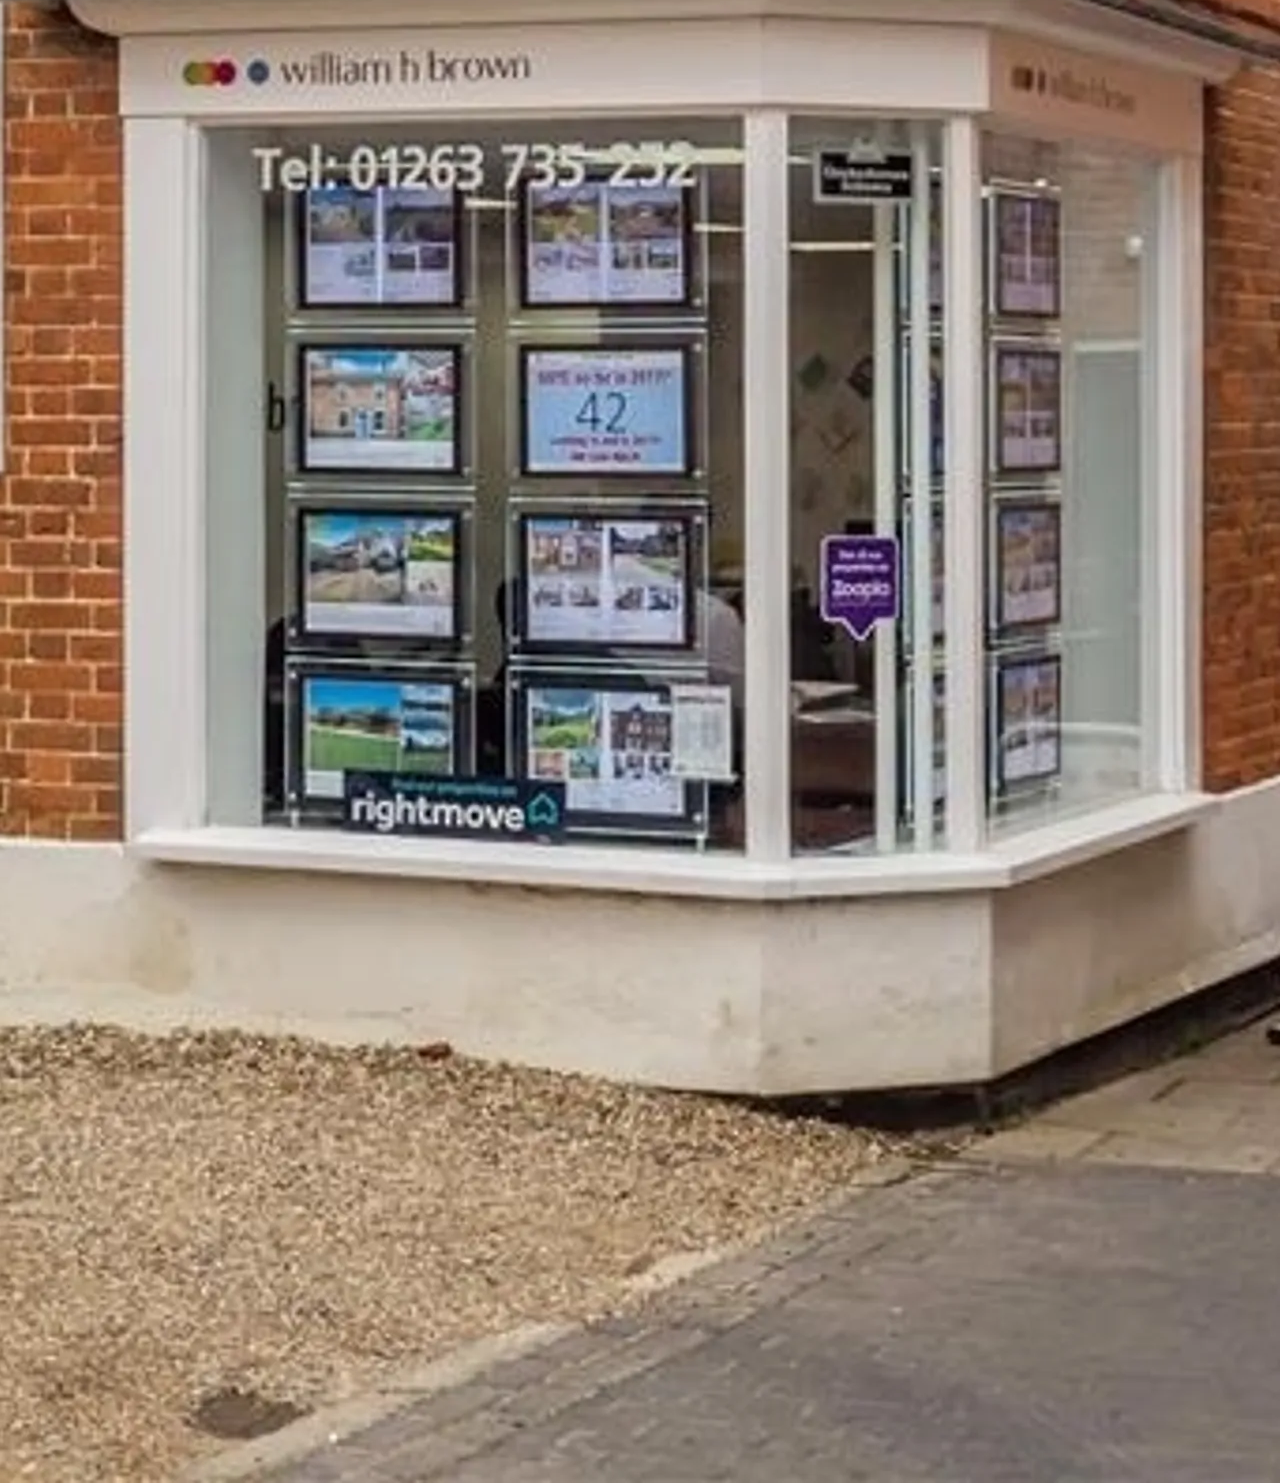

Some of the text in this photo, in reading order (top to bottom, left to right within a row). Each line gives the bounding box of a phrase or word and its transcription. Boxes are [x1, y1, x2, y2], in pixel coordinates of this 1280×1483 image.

[280, 49, 531, 85] william h brown
[252, 144, 338, 192] Tel:
[349, 143, 484, 191] 01263
[501, 143, 586, 190] 735
[575, 391, 628, 434] 42
[350, 791, 525, 832] rightmove
